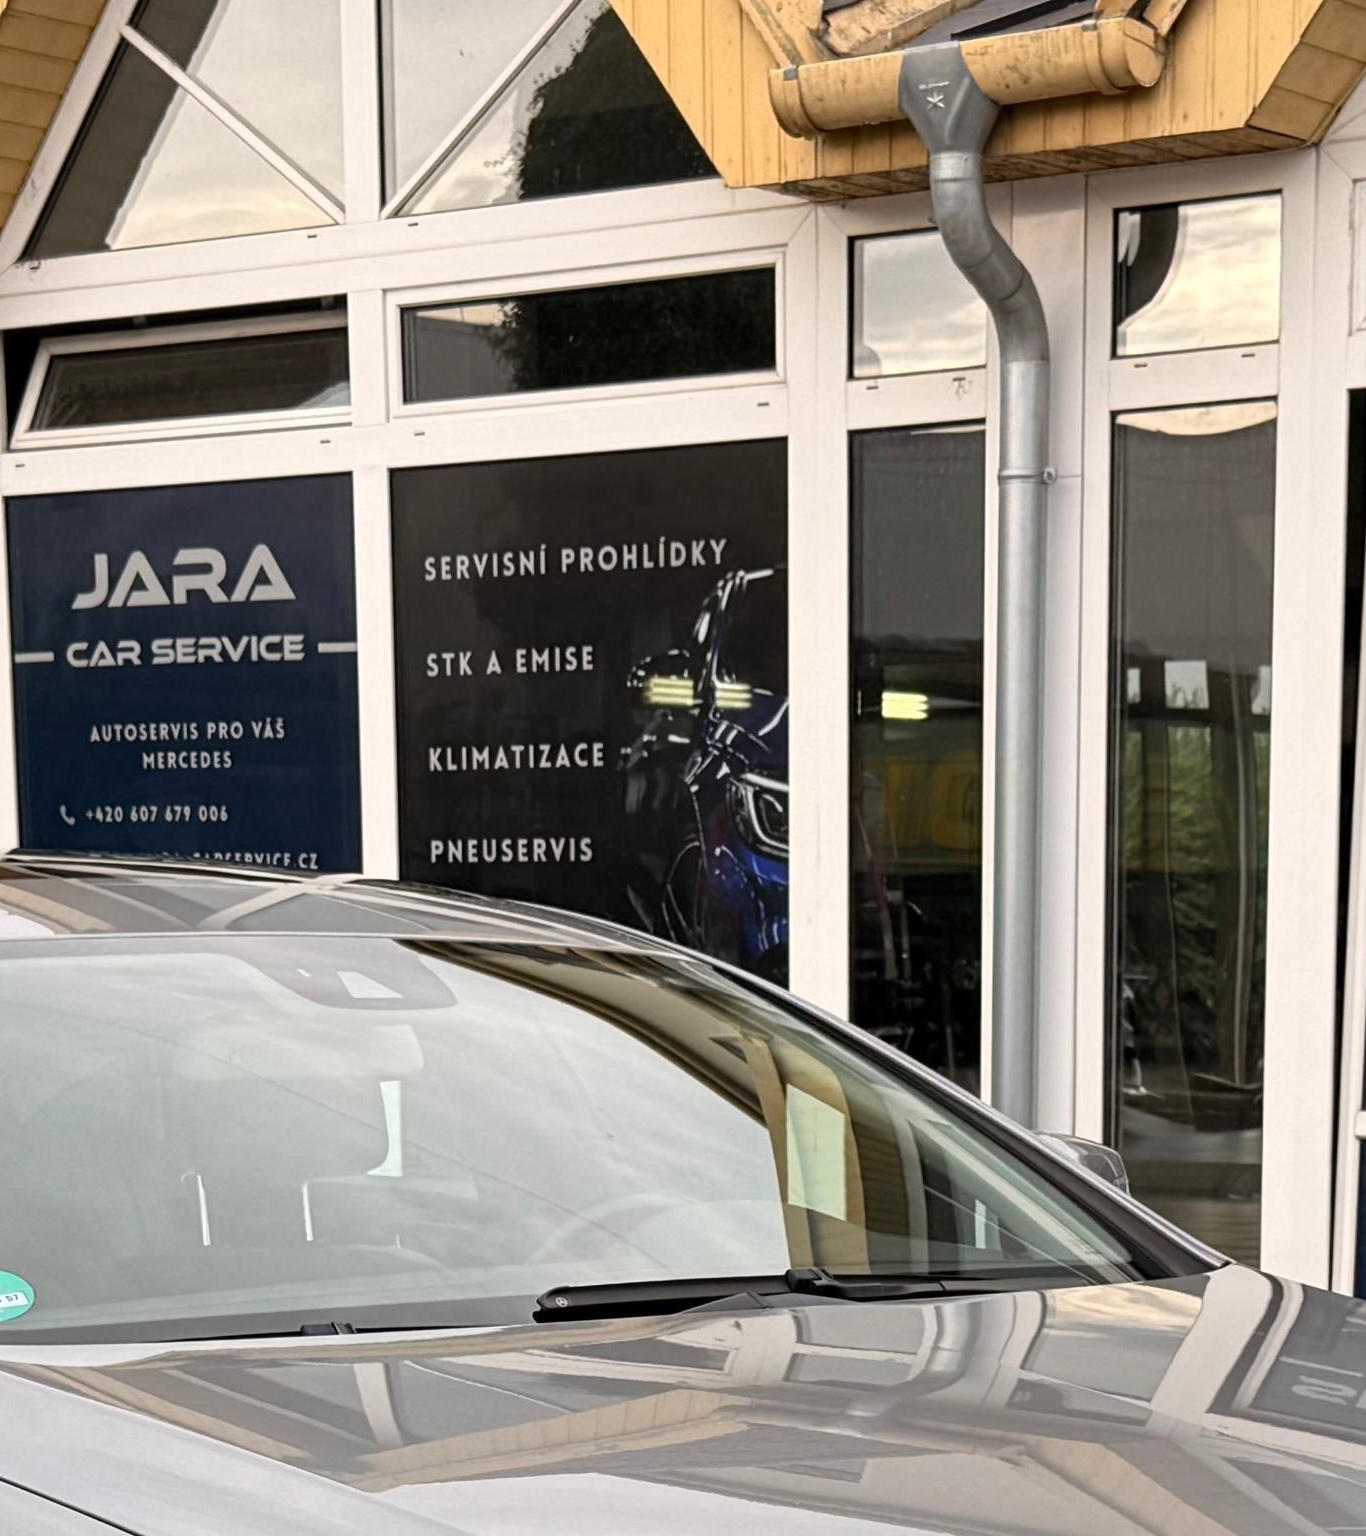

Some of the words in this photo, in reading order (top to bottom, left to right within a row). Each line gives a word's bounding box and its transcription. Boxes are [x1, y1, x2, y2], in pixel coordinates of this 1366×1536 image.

[424, 543, 548, 581] SERVISNÍ
[560, 536, 728, 575] PROHLÍDKY
[71, 542, 297, 611] JARA
[66, 640, 143, 668] CAR
[151, 634, 305, 665] SERVICE
[426, 652, 474, 677] STK
[486, 650, 504, 674] A
[516, 645, 595, 673] EMISE
[90, 721, 202, 742] AUTOSERVIS
[207, 720, 245, 741] PRO
[250, 716, 286, 740] VÁŠ
[142, 752, 234, 770] MERCEDES
[428, 743, 605, 772] KLIMATIZACE
[86, 805, 123, 824] +420
[130, 805, 158, 823] 607
[165, 804, 191, 822] 679
[199, 804, 228, 822] 006
[430, 838, 594, 864] PNEUSERVIS
